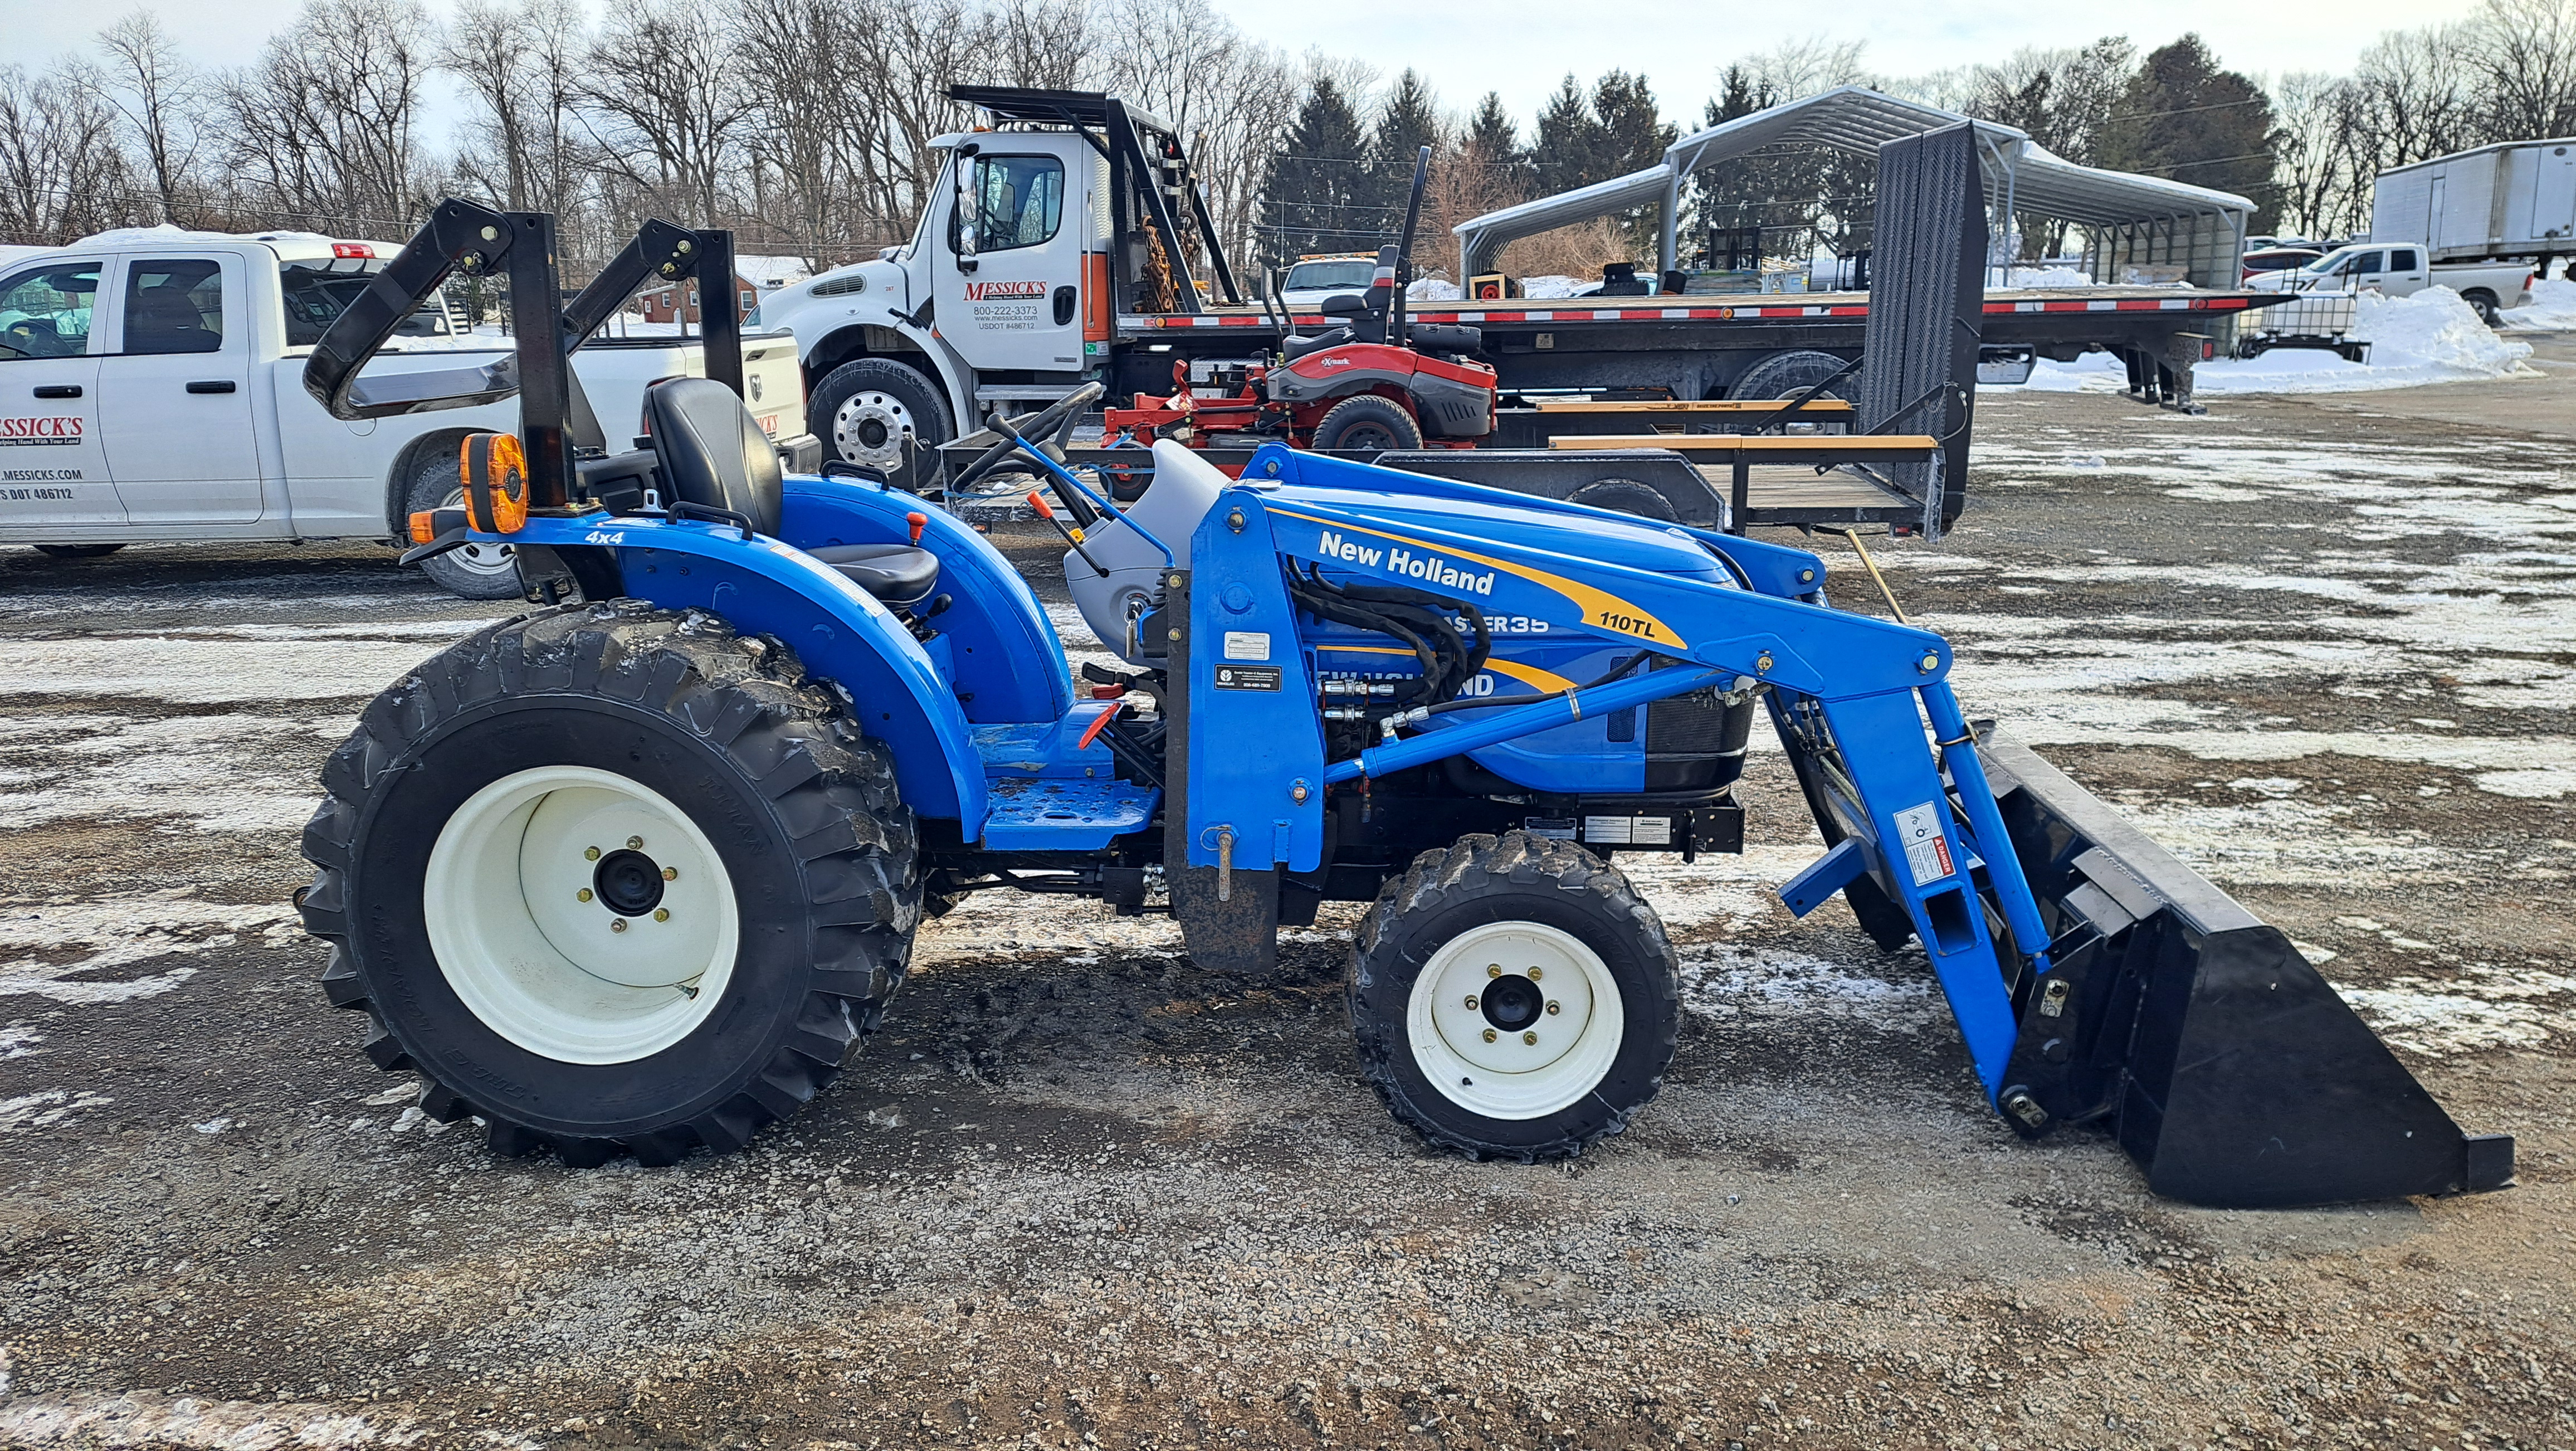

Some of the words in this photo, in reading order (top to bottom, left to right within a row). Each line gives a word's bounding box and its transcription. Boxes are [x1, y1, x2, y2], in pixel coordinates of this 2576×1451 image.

[963, 281, 1047, 300] MESSICK'S
[974, 306, 1037, 315] 800-222-3373
[0, 417, 82, 437] SSICK'S
[1, 469, 82, 480] .MESSICKS.COM
[0, 489, 8, 500] S
[9, 489, 31, 500] DOT
[34, 488, 73, 500] 486712
[585, 530, 625, 544] 4x4
[1319, 530, 1382, 567] New
[1387, 547, 1495, 596] Holland
[1600, 611, 1655, 639] 110TL
[699, 776, 768, 856] TITAN
[1938, 845, 1951, 873] DANGER
